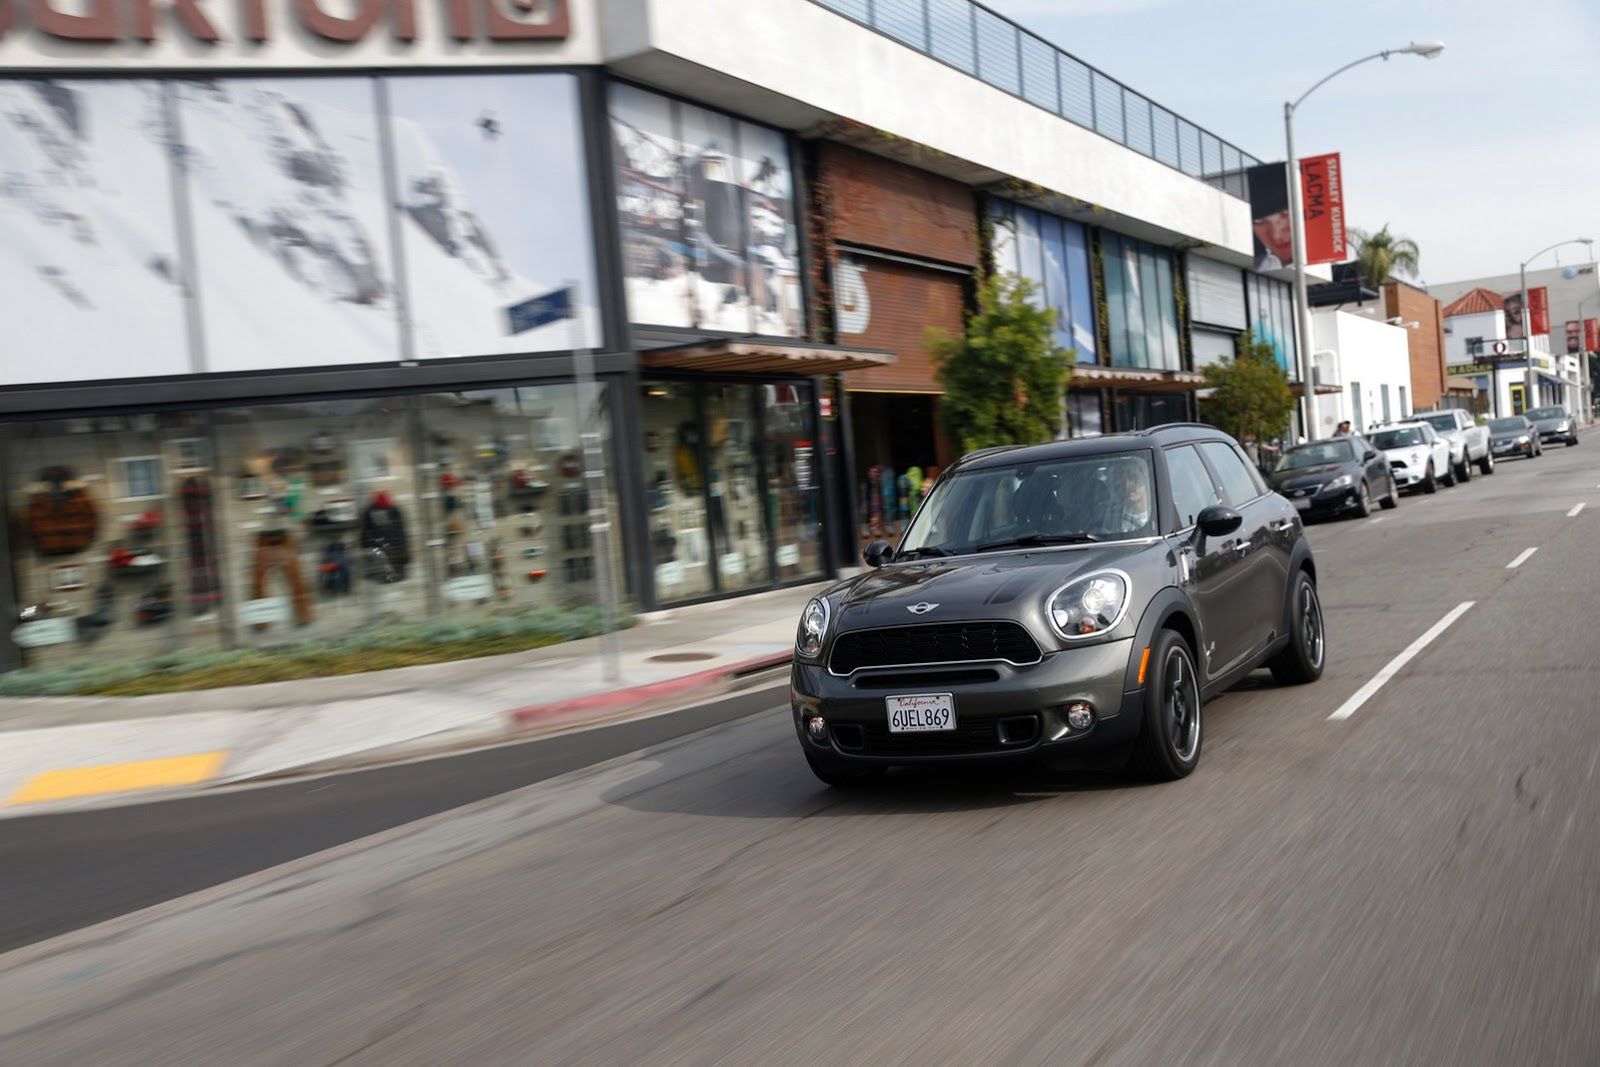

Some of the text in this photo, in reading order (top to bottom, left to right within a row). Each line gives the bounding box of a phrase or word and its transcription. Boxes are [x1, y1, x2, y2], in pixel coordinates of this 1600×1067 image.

[1305, 160, 1325, 220] LACMA
[1326, 158, 1344, 253] STANLEY KUBRICK
[892, 708, 950, 727] 6UEL869
[899, 697, 939, 709] California
